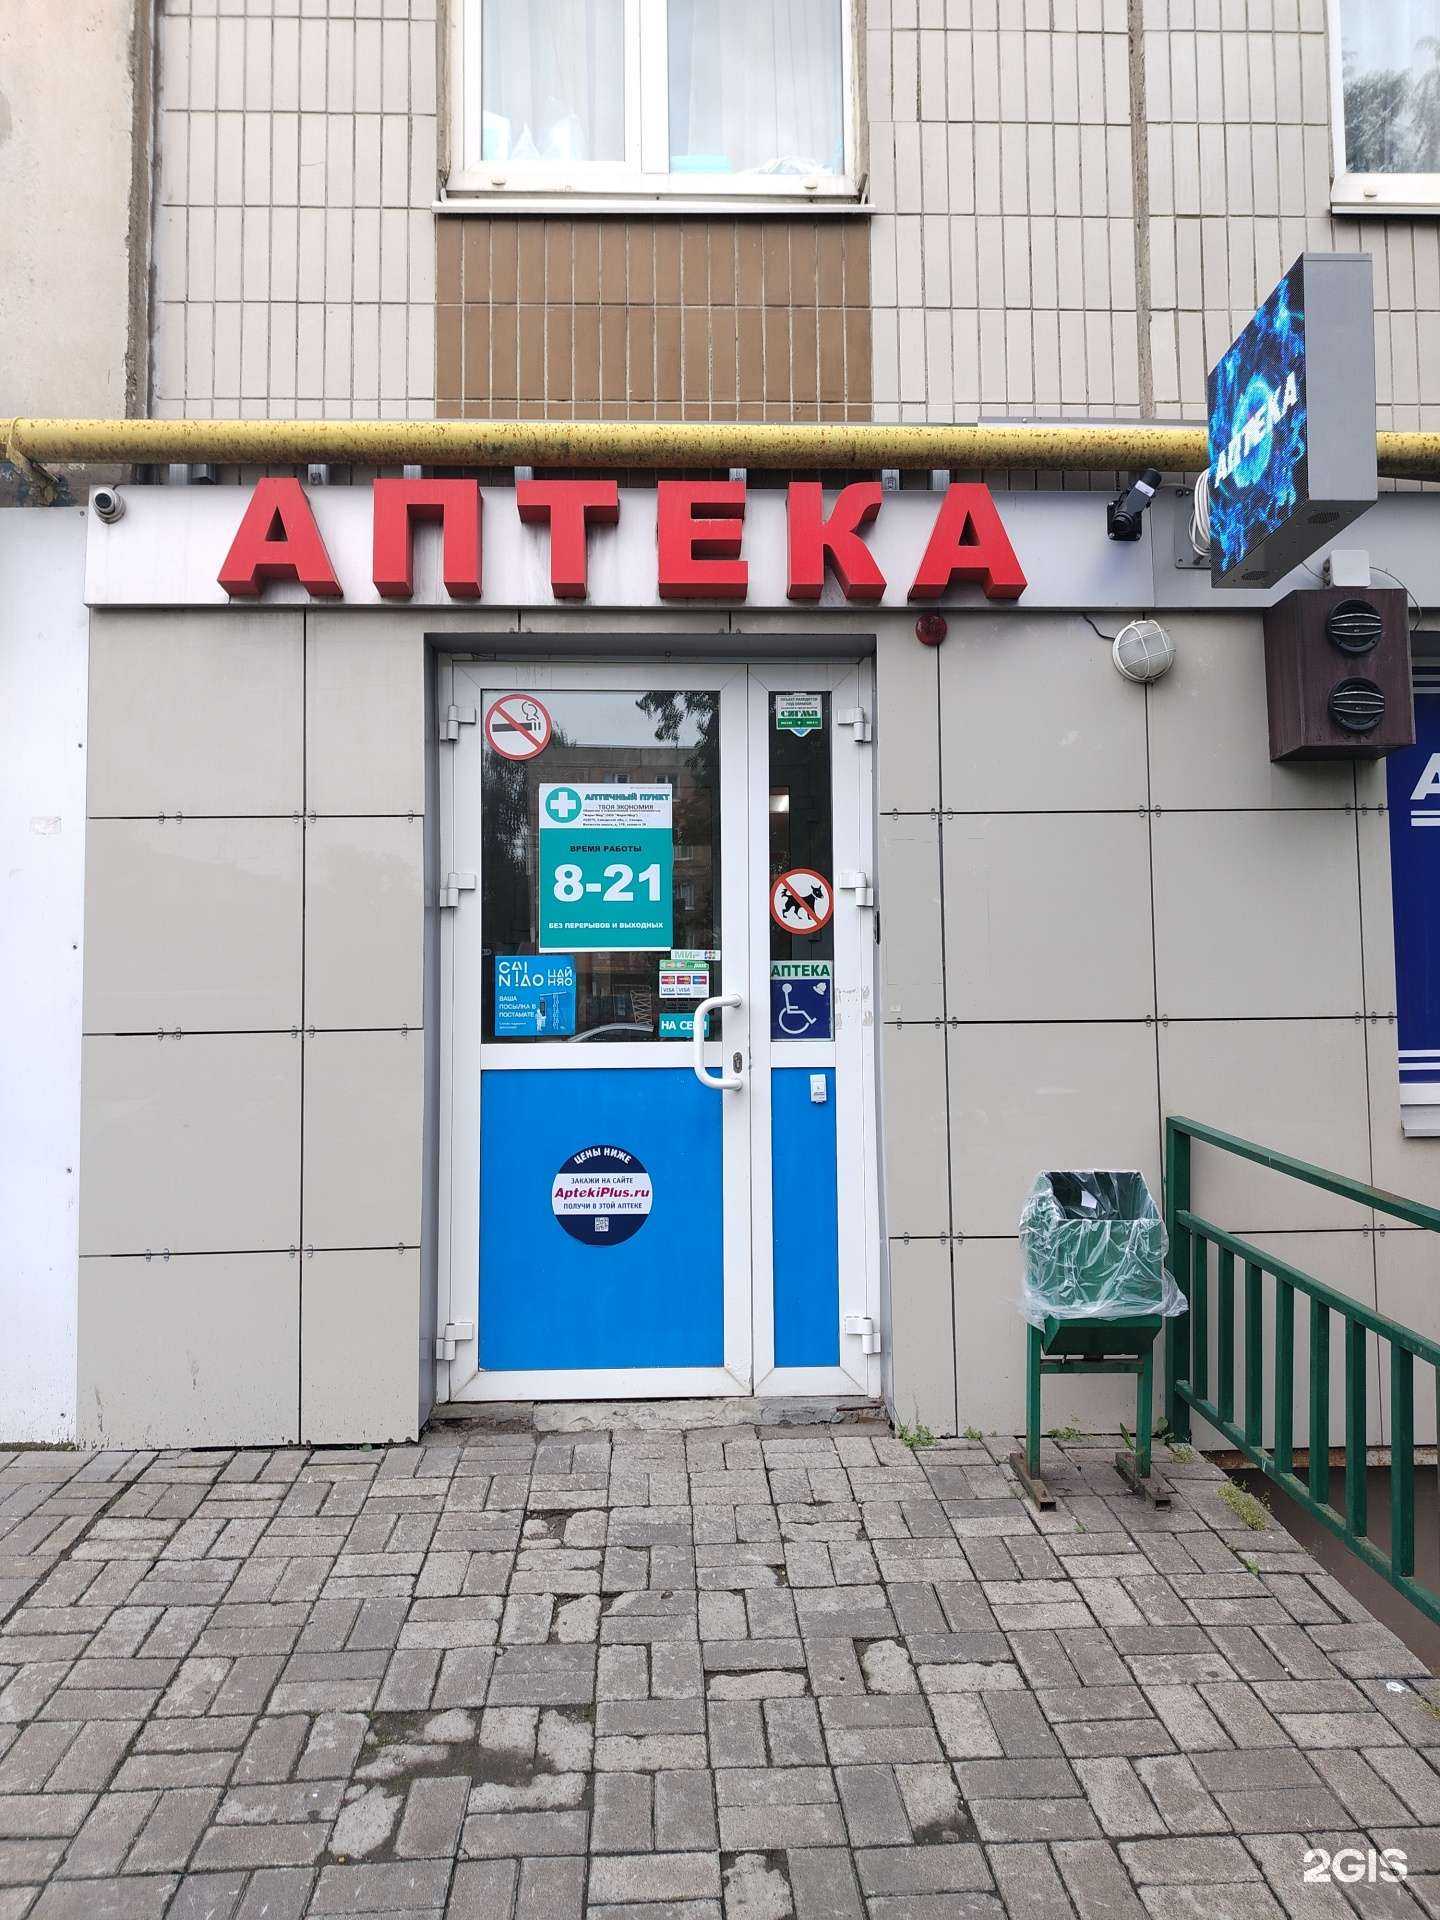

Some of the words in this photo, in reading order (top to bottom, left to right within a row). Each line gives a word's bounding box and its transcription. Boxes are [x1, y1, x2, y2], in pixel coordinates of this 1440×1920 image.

[217, 476, 1028, 600] АПТЕКА
[584, 792, 637, 800] АПТЕЧНЫЙ
[570, 845, 600, 853] ВРЕМЯ
[604, 845, 642, 853] РАБОТЫ
[553, 863, 661, 902] 8-21
[619, 922, 664, 930] ВЫХОДНЫХ
[547, 966, 573, 978] ЦАЙ
[770, 964, 831, 977] АПТЕКА
[547, 978, 573, 987] НЯО
[661, 1020, 677, 1031] НА
[573, 1147, 601, 1165] ЦЕНЫ
[603, 1147, 632, 1165] НИЖЕ
[612, 1176, 634, 1184] САЙТЕ
[554, 1186, 650, 1200] AptekiPlus.ru
[598, 1201, 616, 1209] ЭТОЙ
